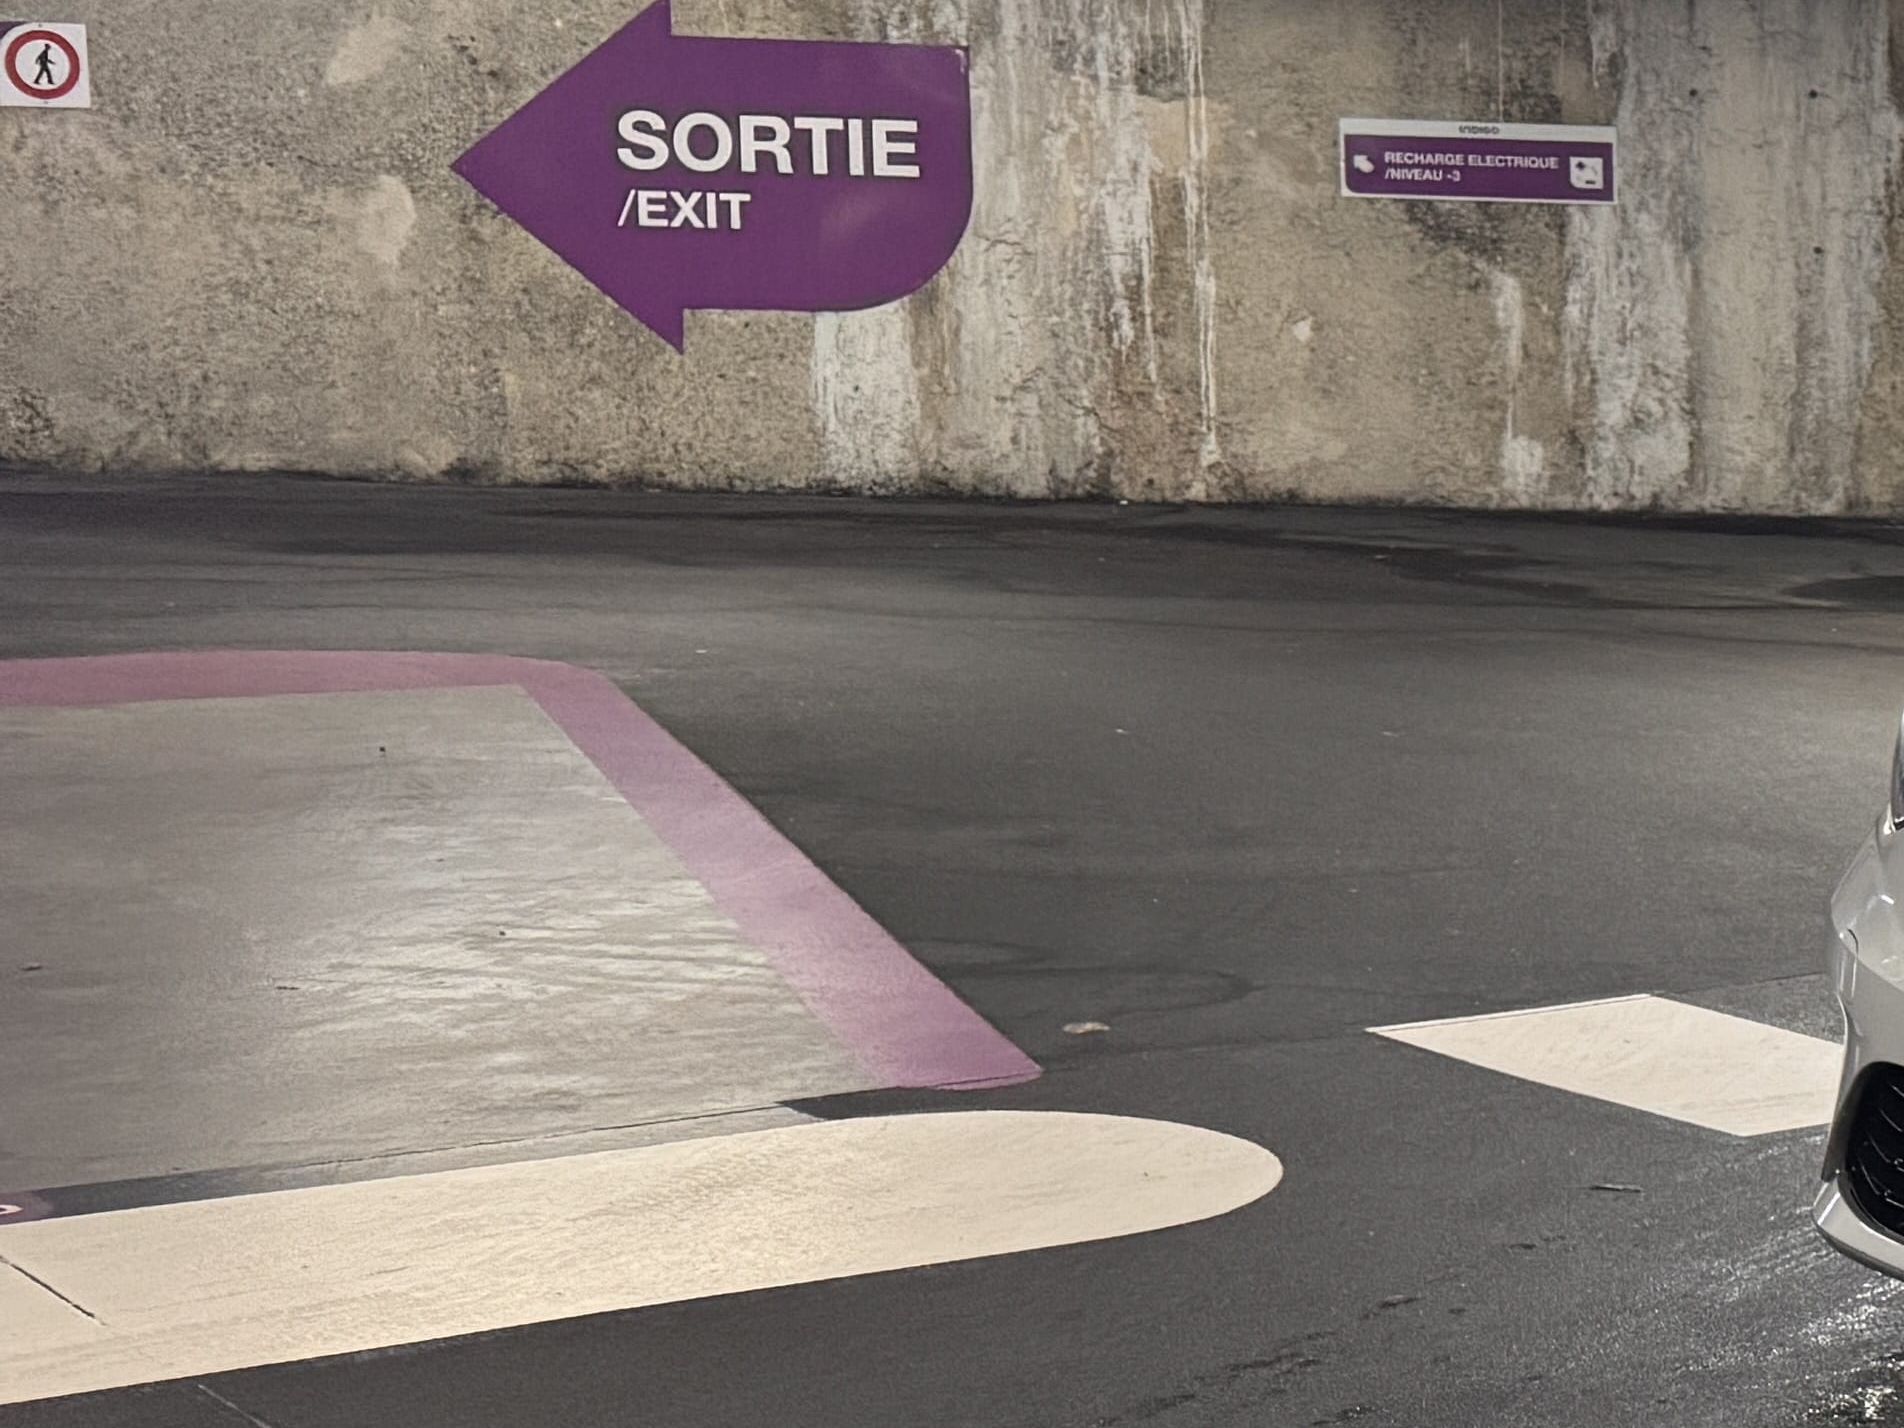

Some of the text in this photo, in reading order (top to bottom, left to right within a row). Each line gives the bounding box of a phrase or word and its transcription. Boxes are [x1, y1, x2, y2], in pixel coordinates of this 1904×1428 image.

[616, 109, 921, 179] SORTIE
[1384, 151, 1560, 169] RECHARGE ELECTRIQUE
[1384, 168, 1443, 181] /NIVEAU
[617, 188, 752, 230] /EXIT
